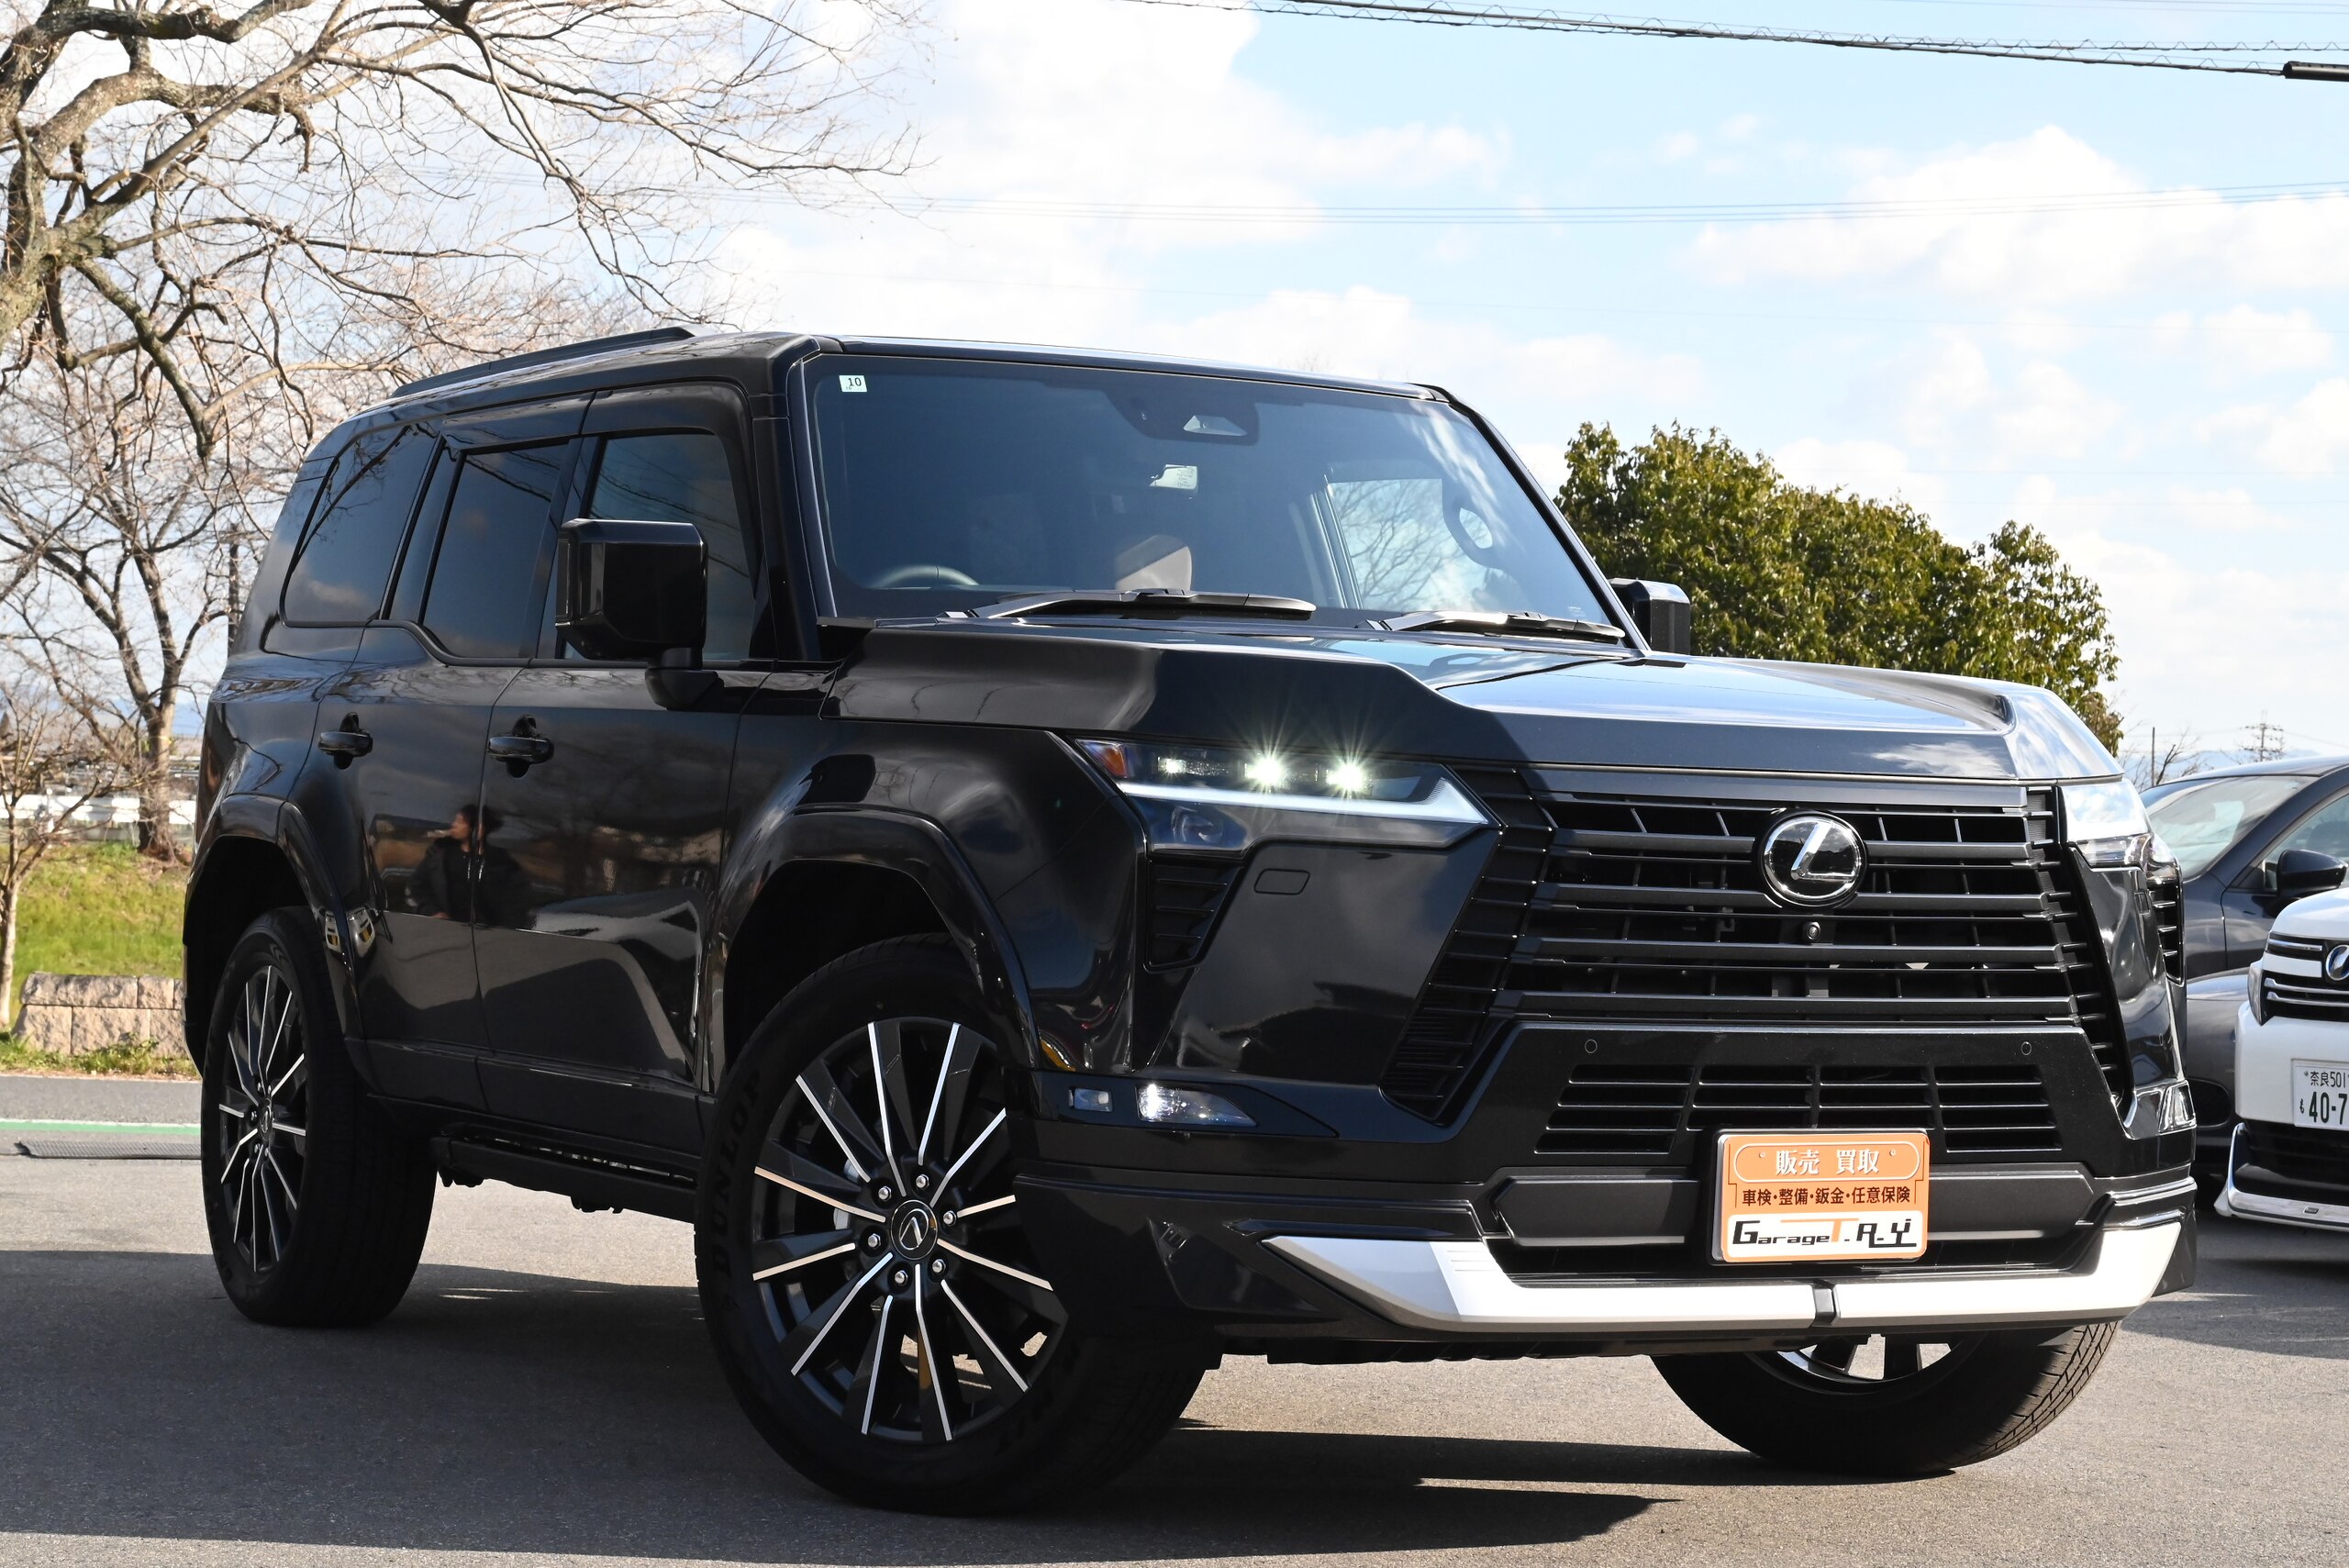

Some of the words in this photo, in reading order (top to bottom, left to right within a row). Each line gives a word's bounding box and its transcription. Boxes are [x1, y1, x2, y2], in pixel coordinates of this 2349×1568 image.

[847, 377, 862, 386] 10
[710, 1068, 762, 1278] DUNLOP
[1776, 1150, 1820, 1175] 販売
[1836, 1149, 1879, 1173] 買取
